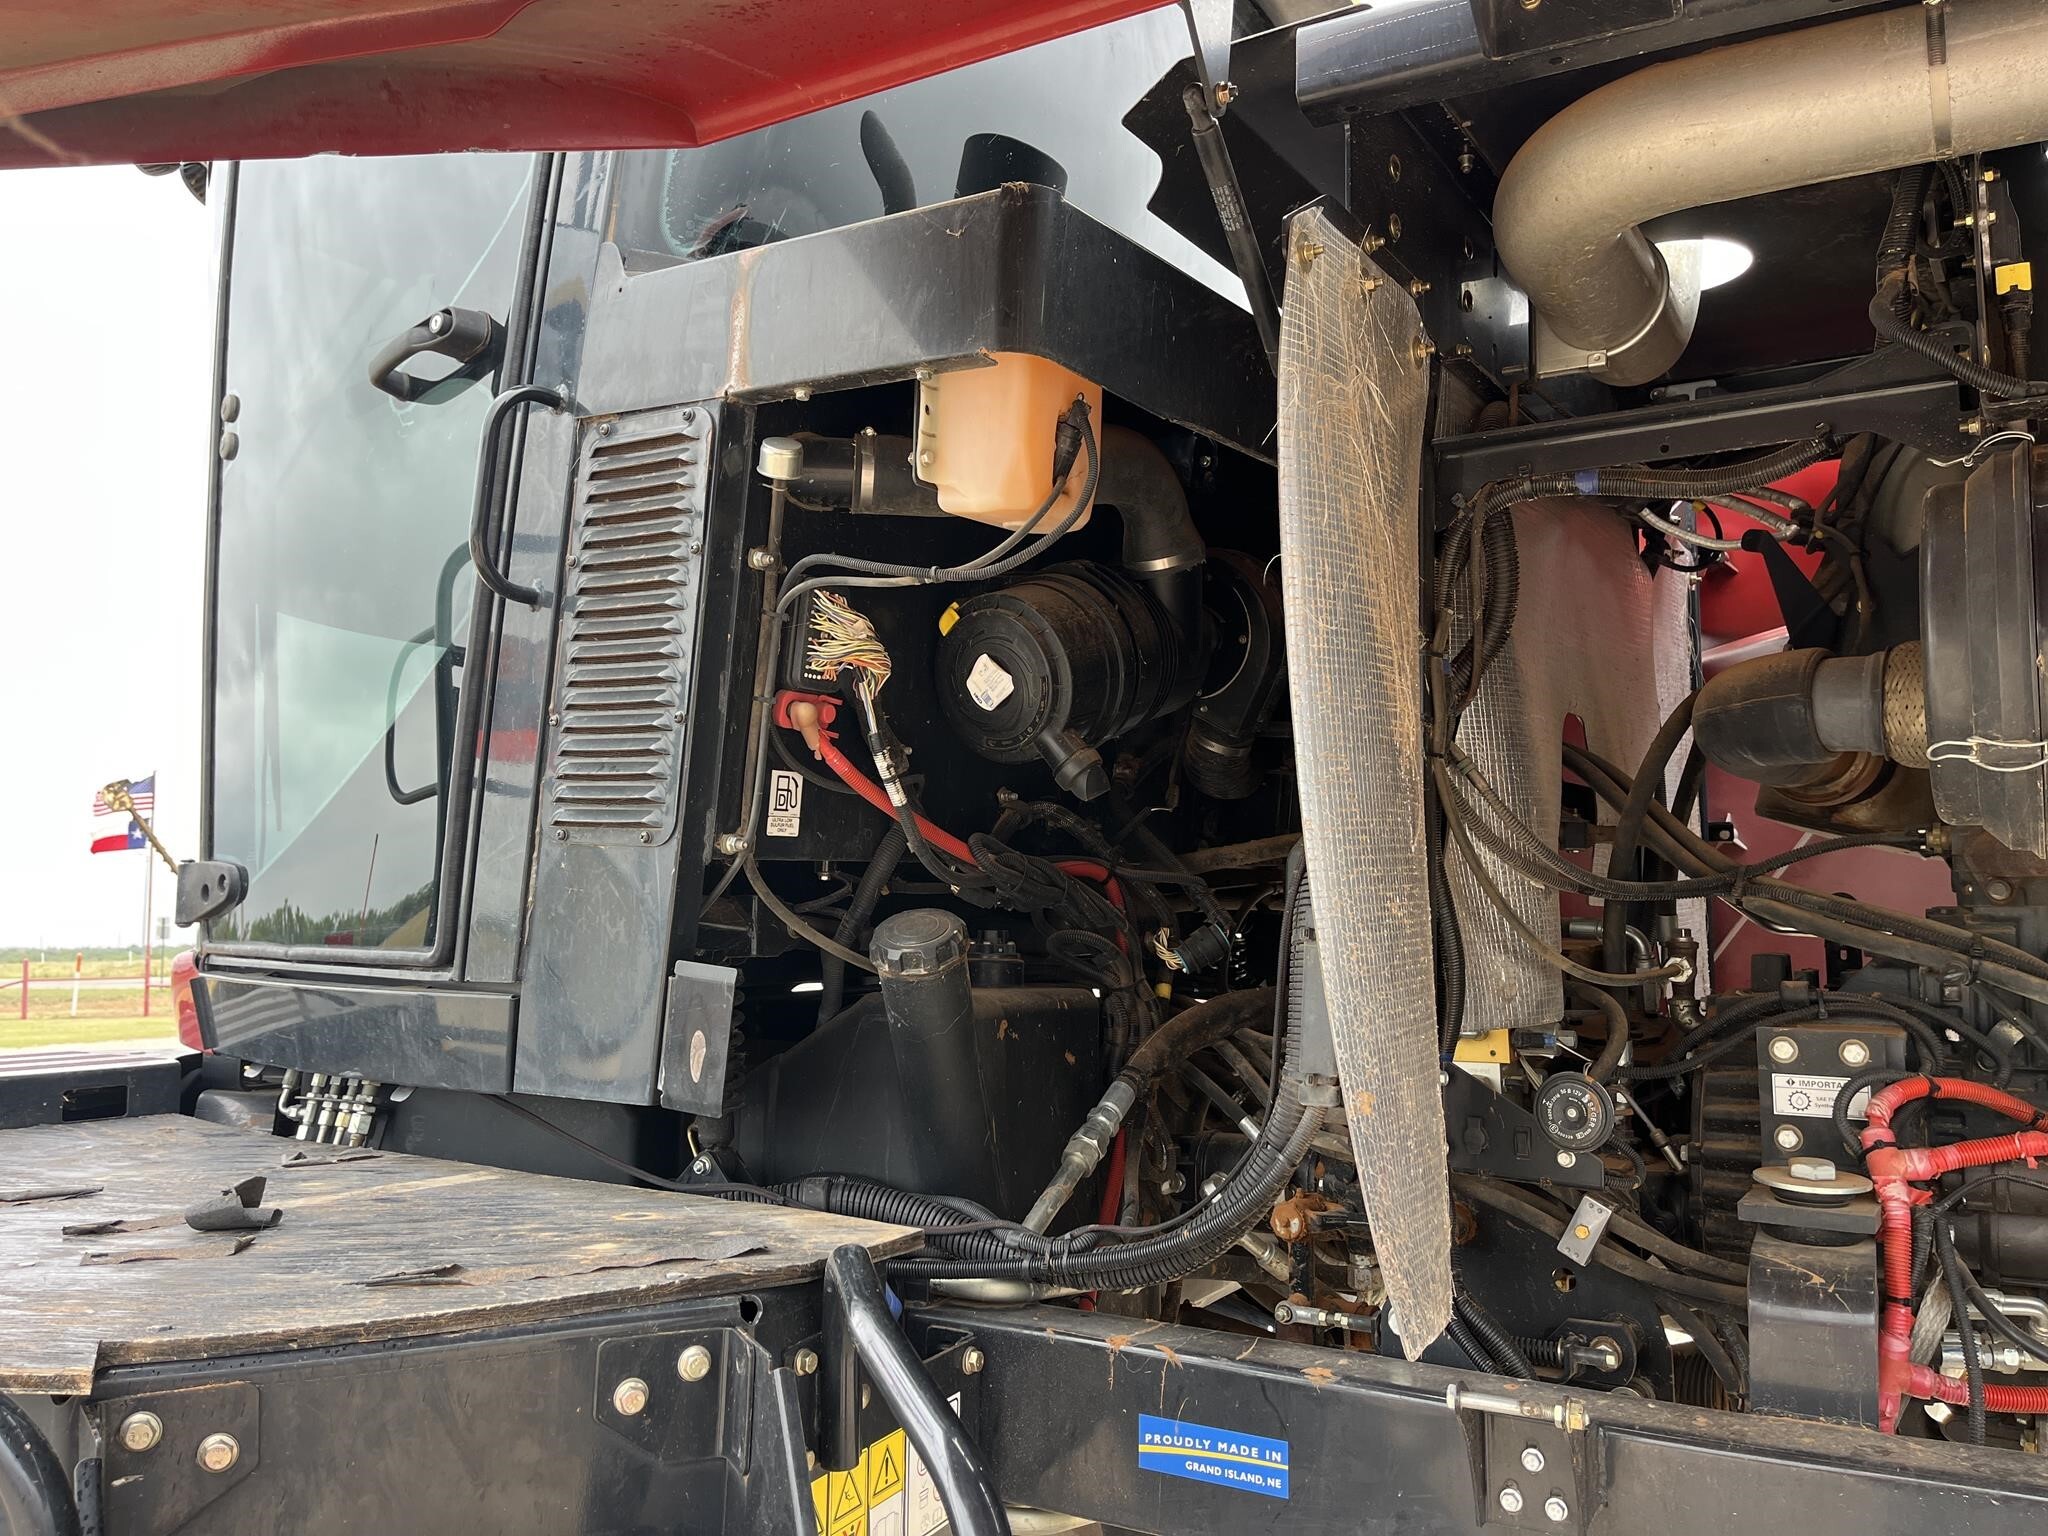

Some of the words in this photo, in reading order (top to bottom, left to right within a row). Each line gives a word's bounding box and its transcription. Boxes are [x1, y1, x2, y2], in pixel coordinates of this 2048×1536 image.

[1798, 1080, 1843, 1089] IMPORTA
[1144, 1433, 1212, 1450] PROUDLY
[1217, 1442, 1259, 1458] MADE
[1265, 1449, 1282, 1463] IN
[1185, 1460, 1222, 1476] GRAND
[1224, 1468, 1266, 1487] ISLAND,
[1266, 1477, 1282, 1489] NE
